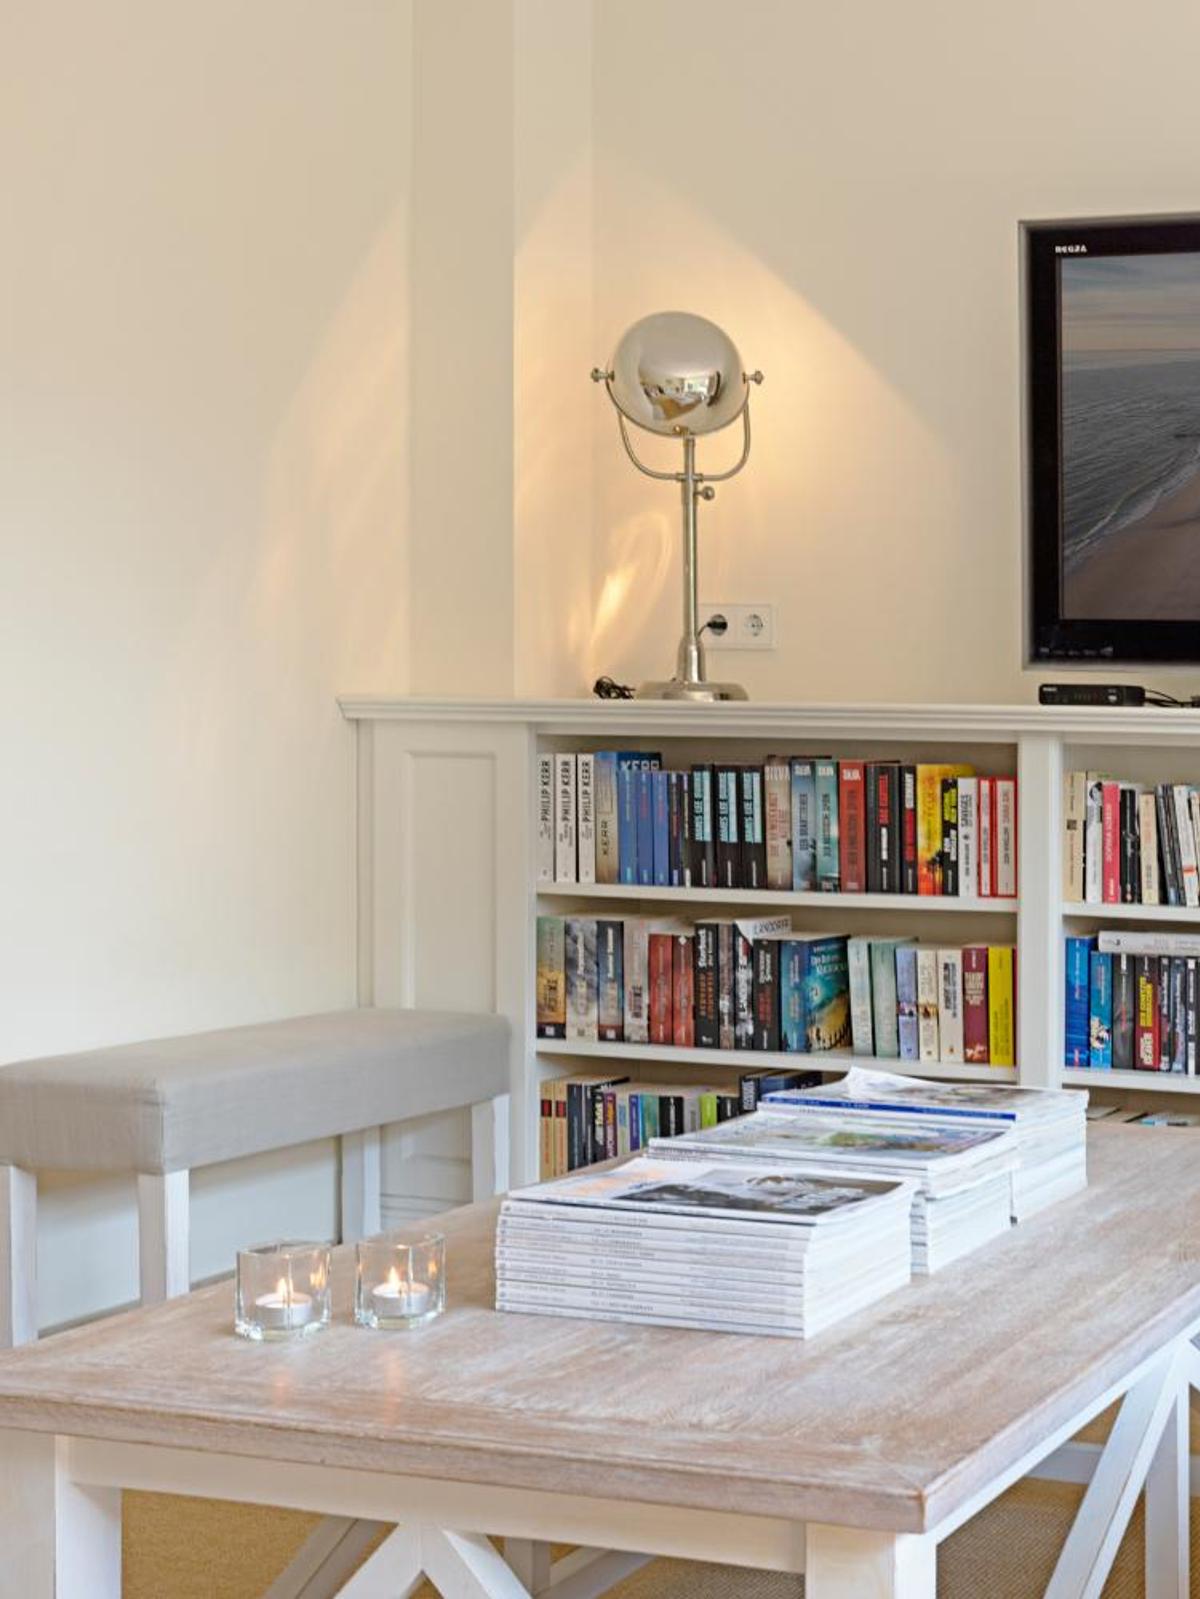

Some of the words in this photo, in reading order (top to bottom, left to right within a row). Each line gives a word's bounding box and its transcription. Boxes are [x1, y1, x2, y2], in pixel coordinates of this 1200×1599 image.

[541, 760, 551, 786] KERR
[561, 760, 571, 786] KERR
[582, 761, 591, 787] KERR
[541, 788, 551, 822] PHILIP
[561, 788, 571, 822] PHILIP
[582, 788, 592, 823] PHILIP
